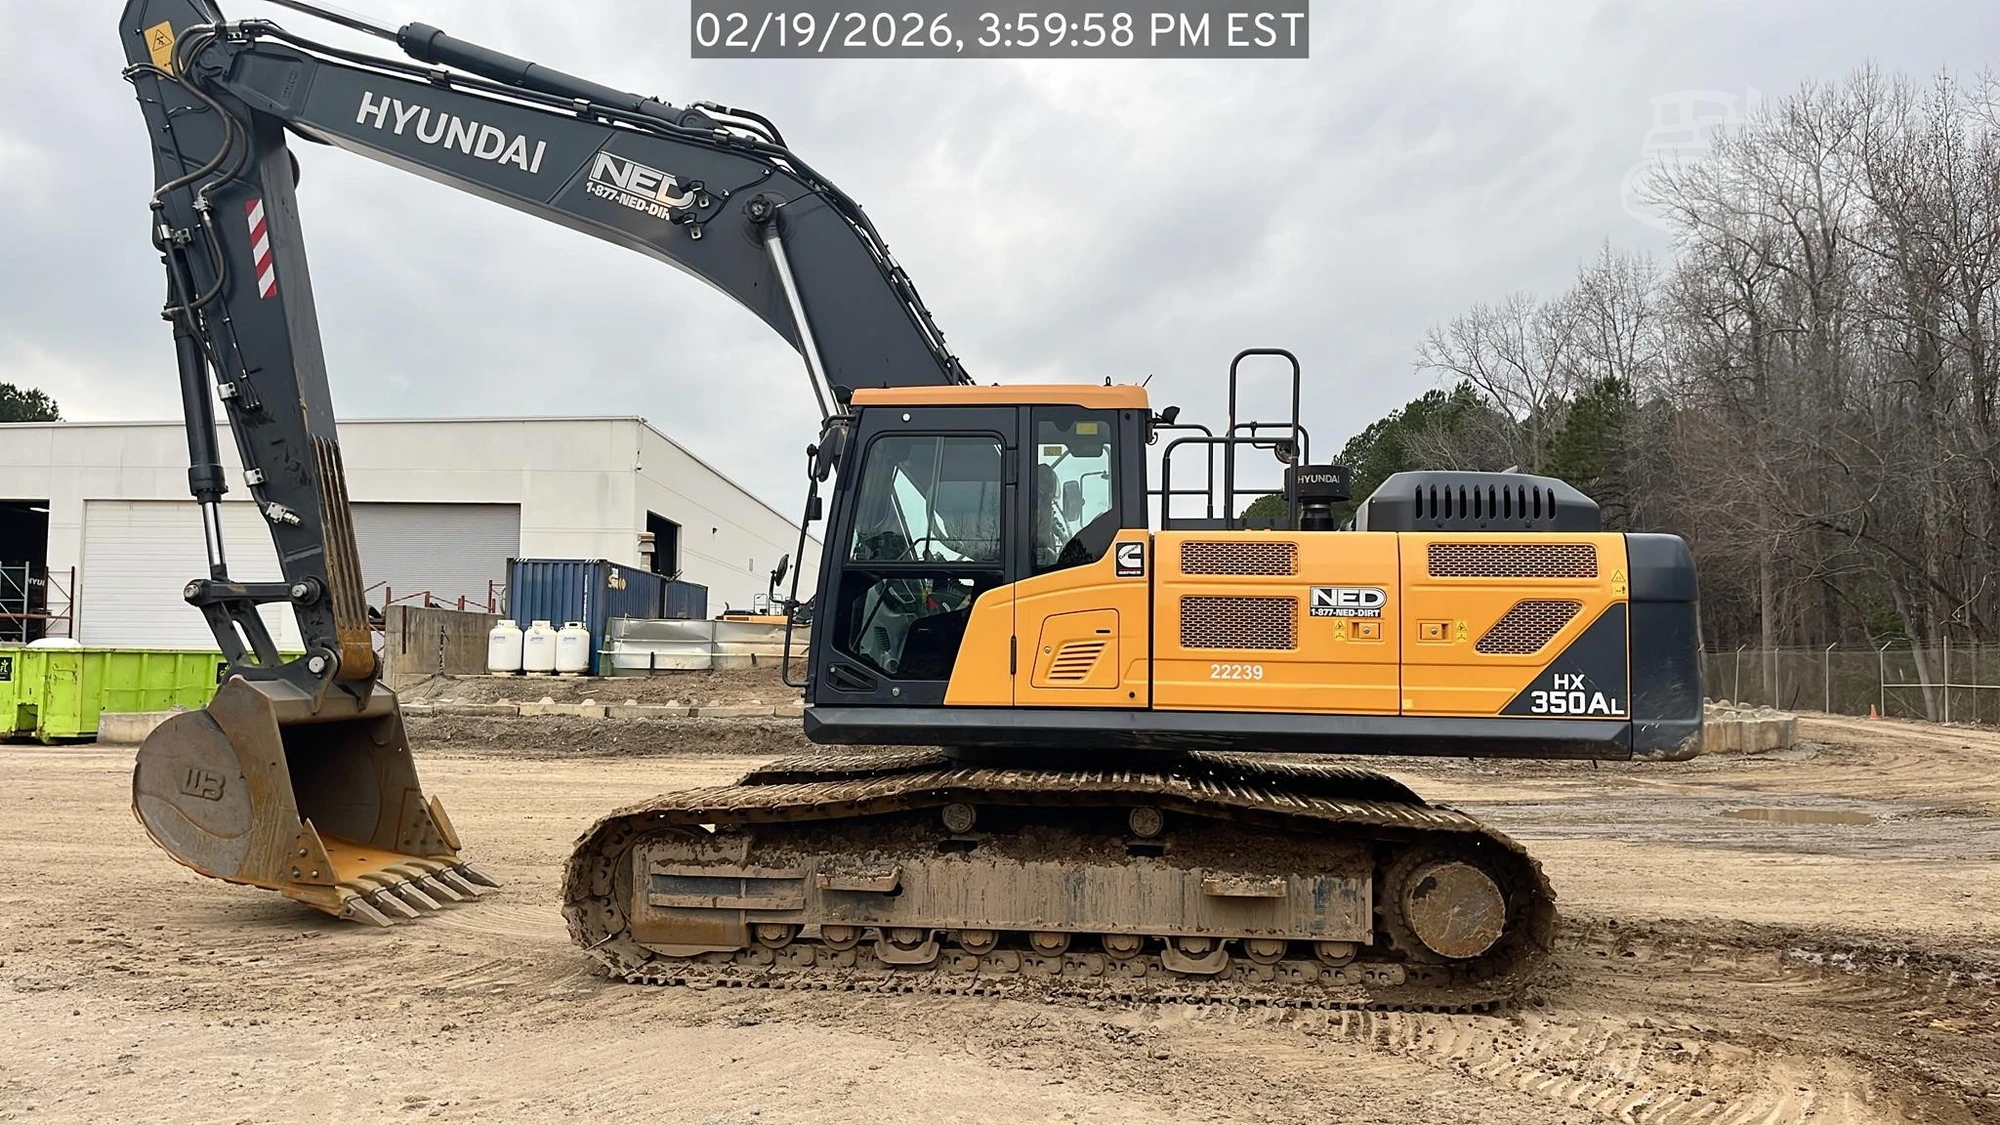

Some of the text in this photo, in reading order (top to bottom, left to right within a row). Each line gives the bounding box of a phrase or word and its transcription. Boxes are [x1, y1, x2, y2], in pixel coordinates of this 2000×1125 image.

[356, 91, 547, 174] HYUNDAI
[592, 152, 695, 207] NED
[586, 181, 671, 221] 1-877-NED-DIR
[1297, 473, 1340, 484] HYUNDAI
[1311, 588, 1386, 607] NED
[1310, 608, 1381, 618] 1-877-NED-DIRT
[1210, 663, 1264, 680] 22239
[1554, 673, 1586, 690] HX
